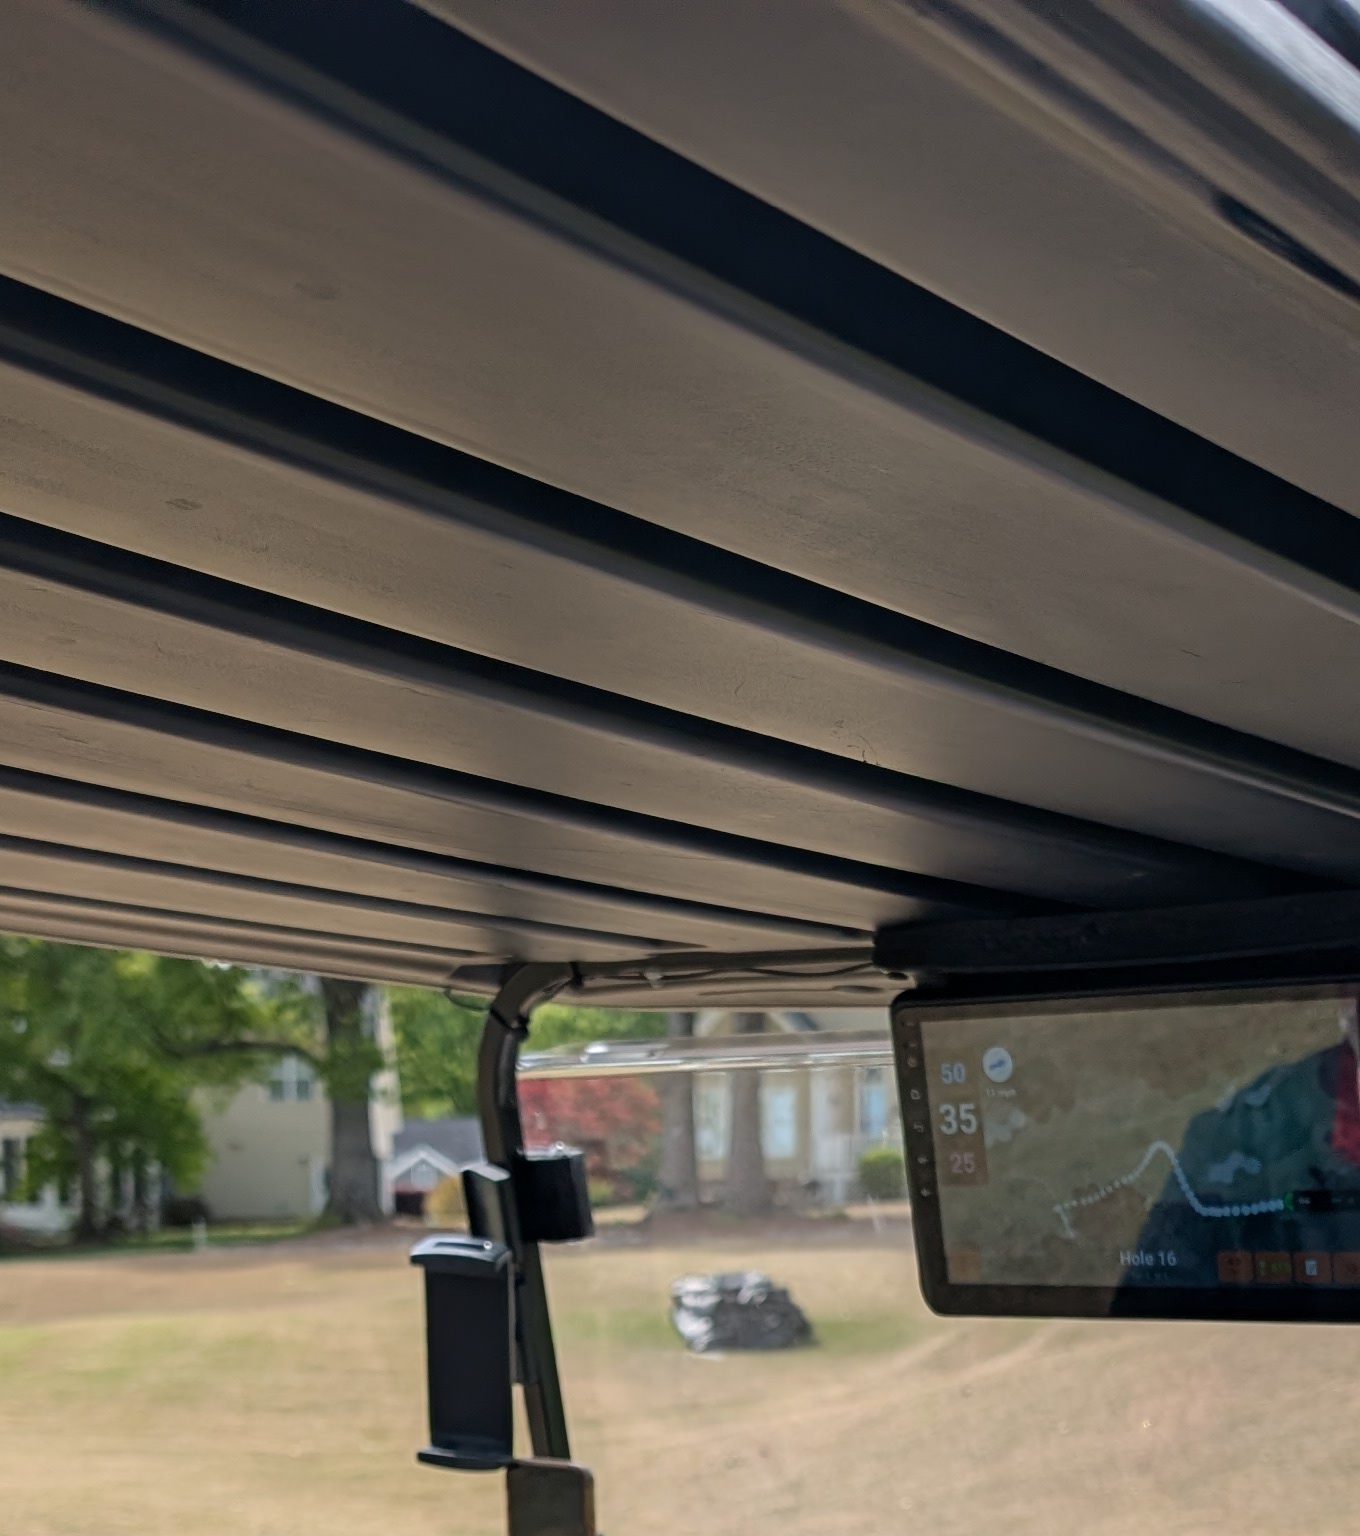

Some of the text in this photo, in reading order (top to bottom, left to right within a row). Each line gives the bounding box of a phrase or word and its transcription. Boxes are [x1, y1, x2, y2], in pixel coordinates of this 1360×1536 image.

[940, 1062, 967, 1085] 50
[939, 1102, 978, 1135] 35
[950, 1151, 976, 1174] 25
[1119, 1249, 1178, 1268] Hole 16
